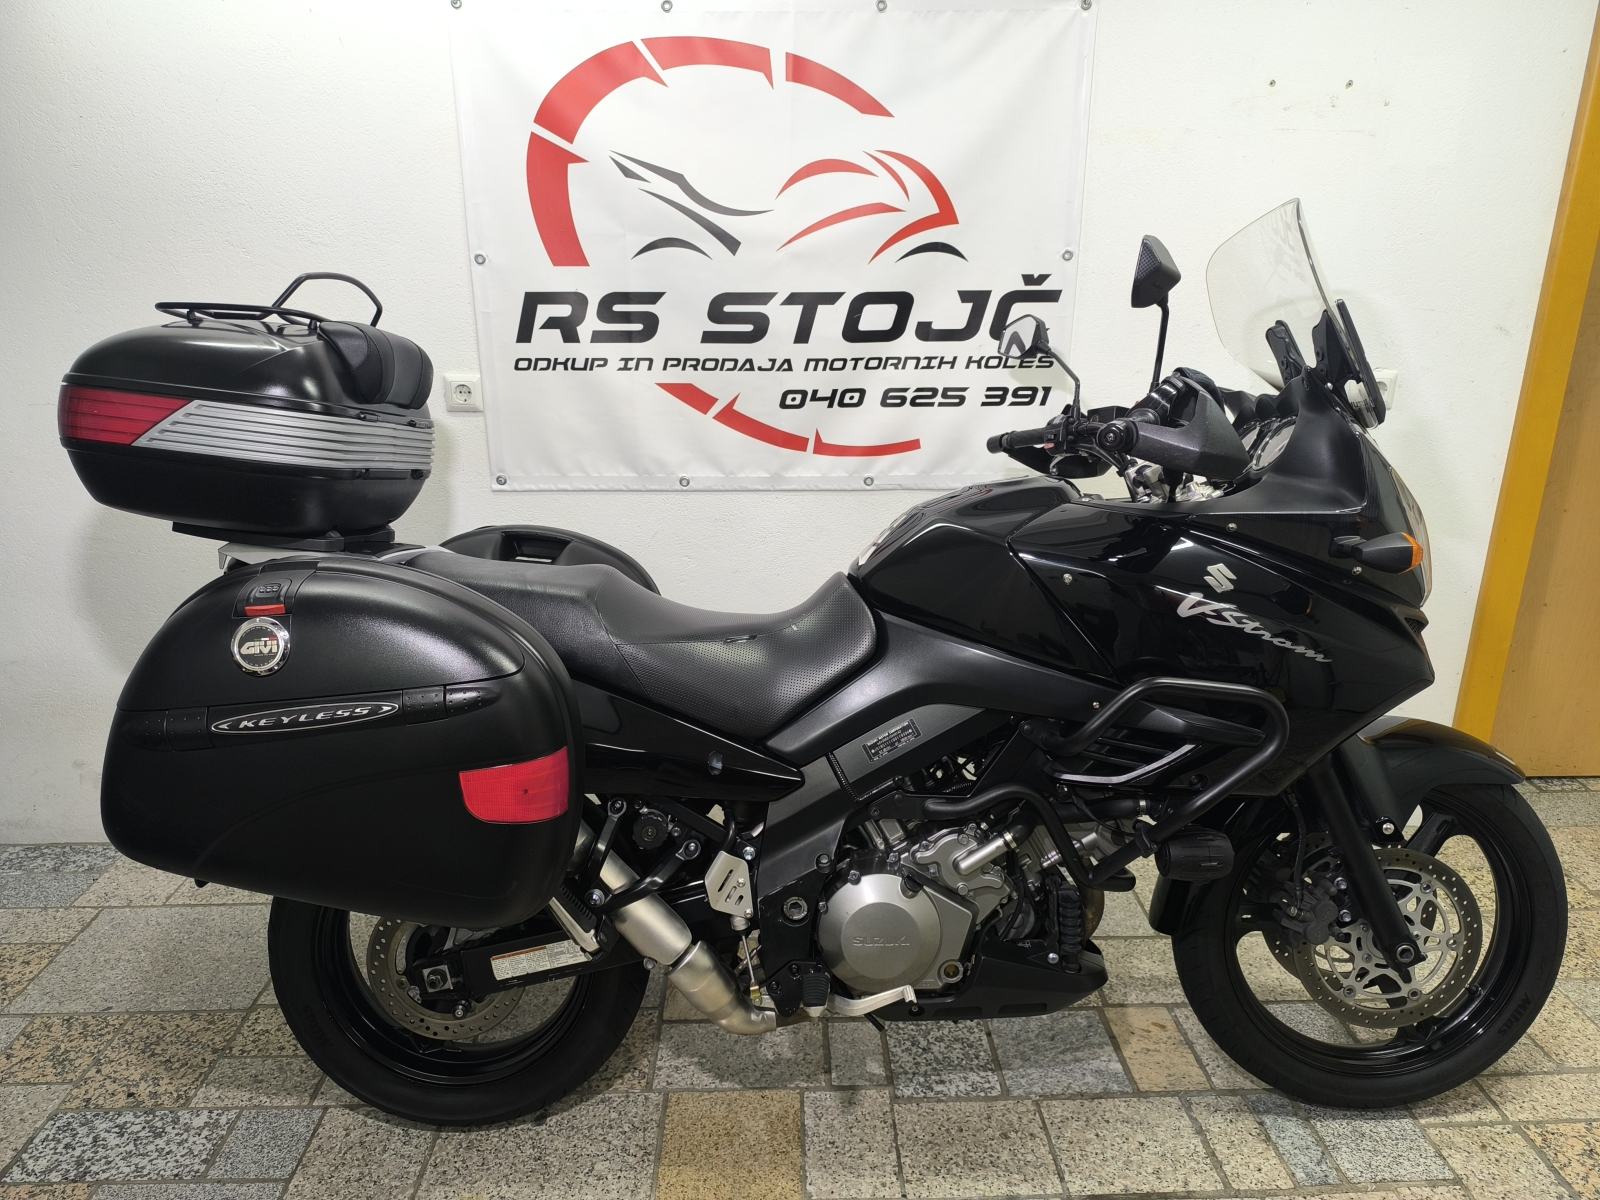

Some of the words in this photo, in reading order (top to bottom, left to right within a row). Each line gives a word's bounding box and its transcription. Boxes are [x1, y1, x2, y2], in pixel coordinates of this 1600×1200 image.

[515, 291, 667, 344] RS
[700, 273, 1063, 345] STOJČ
[513, 357, 609, 372] ODKUP
[616, 357, 655, 372] IN
[662, 357, 795, 372] PRODAJA
[803, 356, 958, 372] MOTORNIH
[964, 355, 1055, 370] KOLES
[777, 387, 868, 410] 040
[879, 386, 971, 408] 625
[980, 386, 1053, 407] 391
[240, 640, 278, 655] GIVI
[238, 706, 373, 729] KEYLESS
